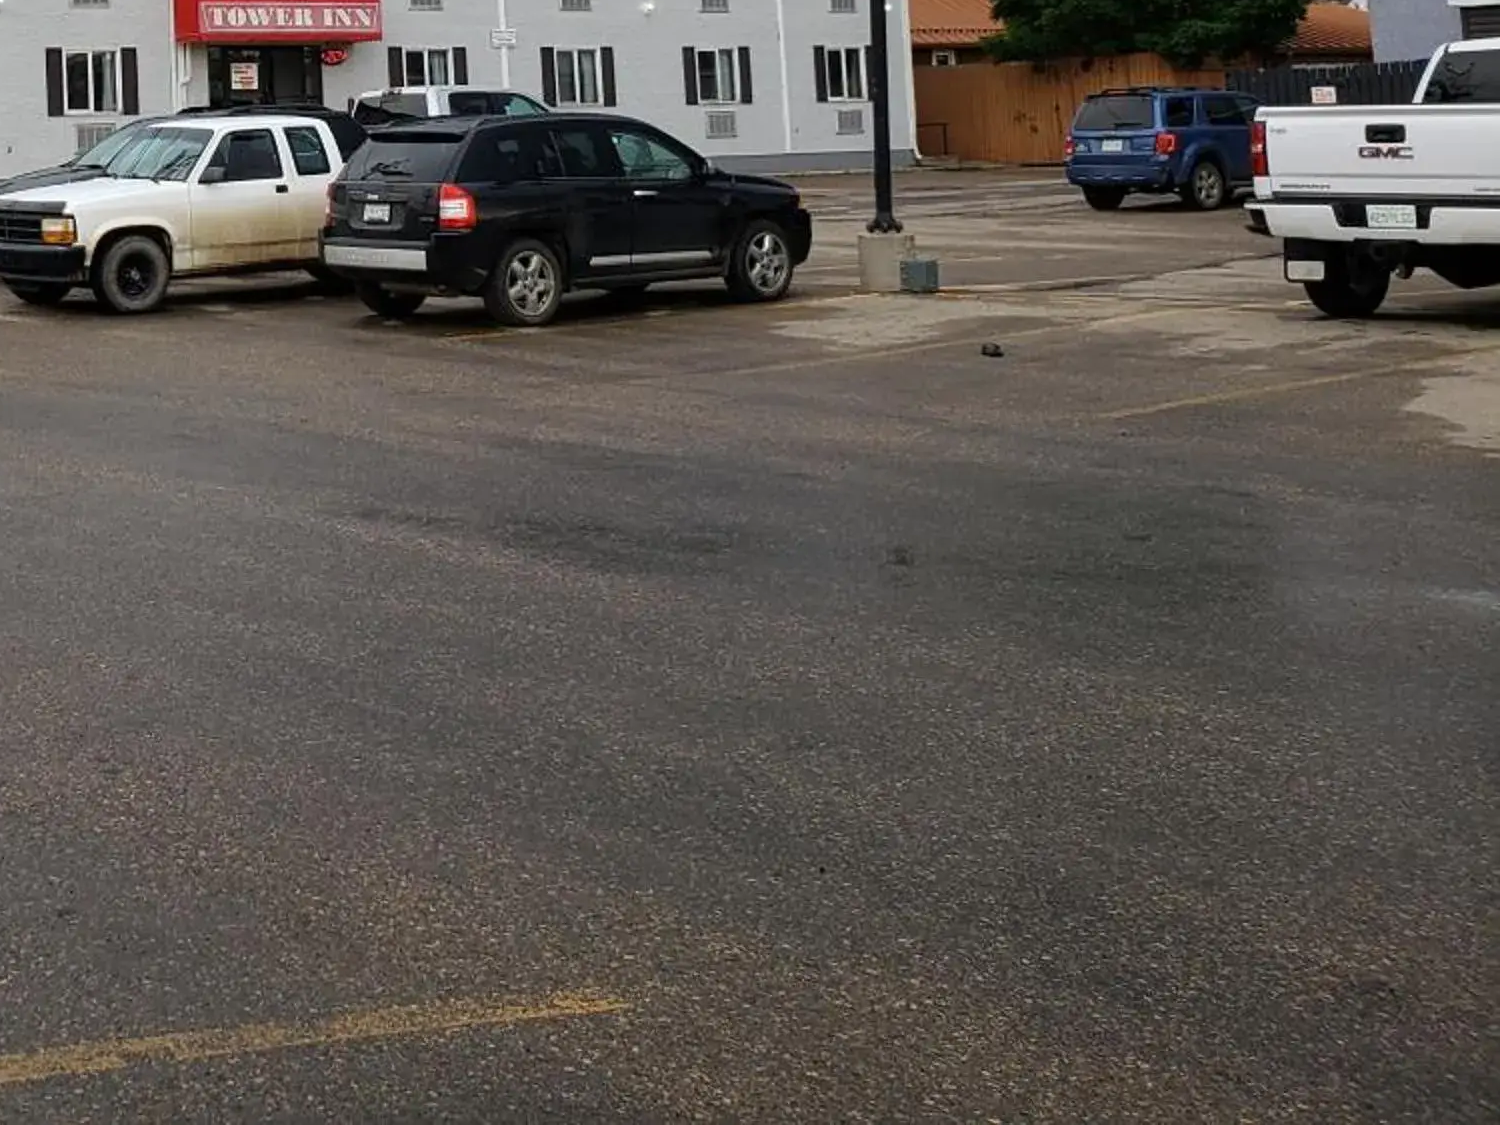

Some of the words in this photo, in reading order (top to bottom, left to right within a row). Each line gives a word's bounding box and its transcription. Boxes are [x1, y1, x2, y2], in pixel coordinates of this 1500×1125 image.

[208, 6, 313, 28] TOWER
[323, 7, 374, 27] INN
[1358, 146, 1415, 159] GMC
